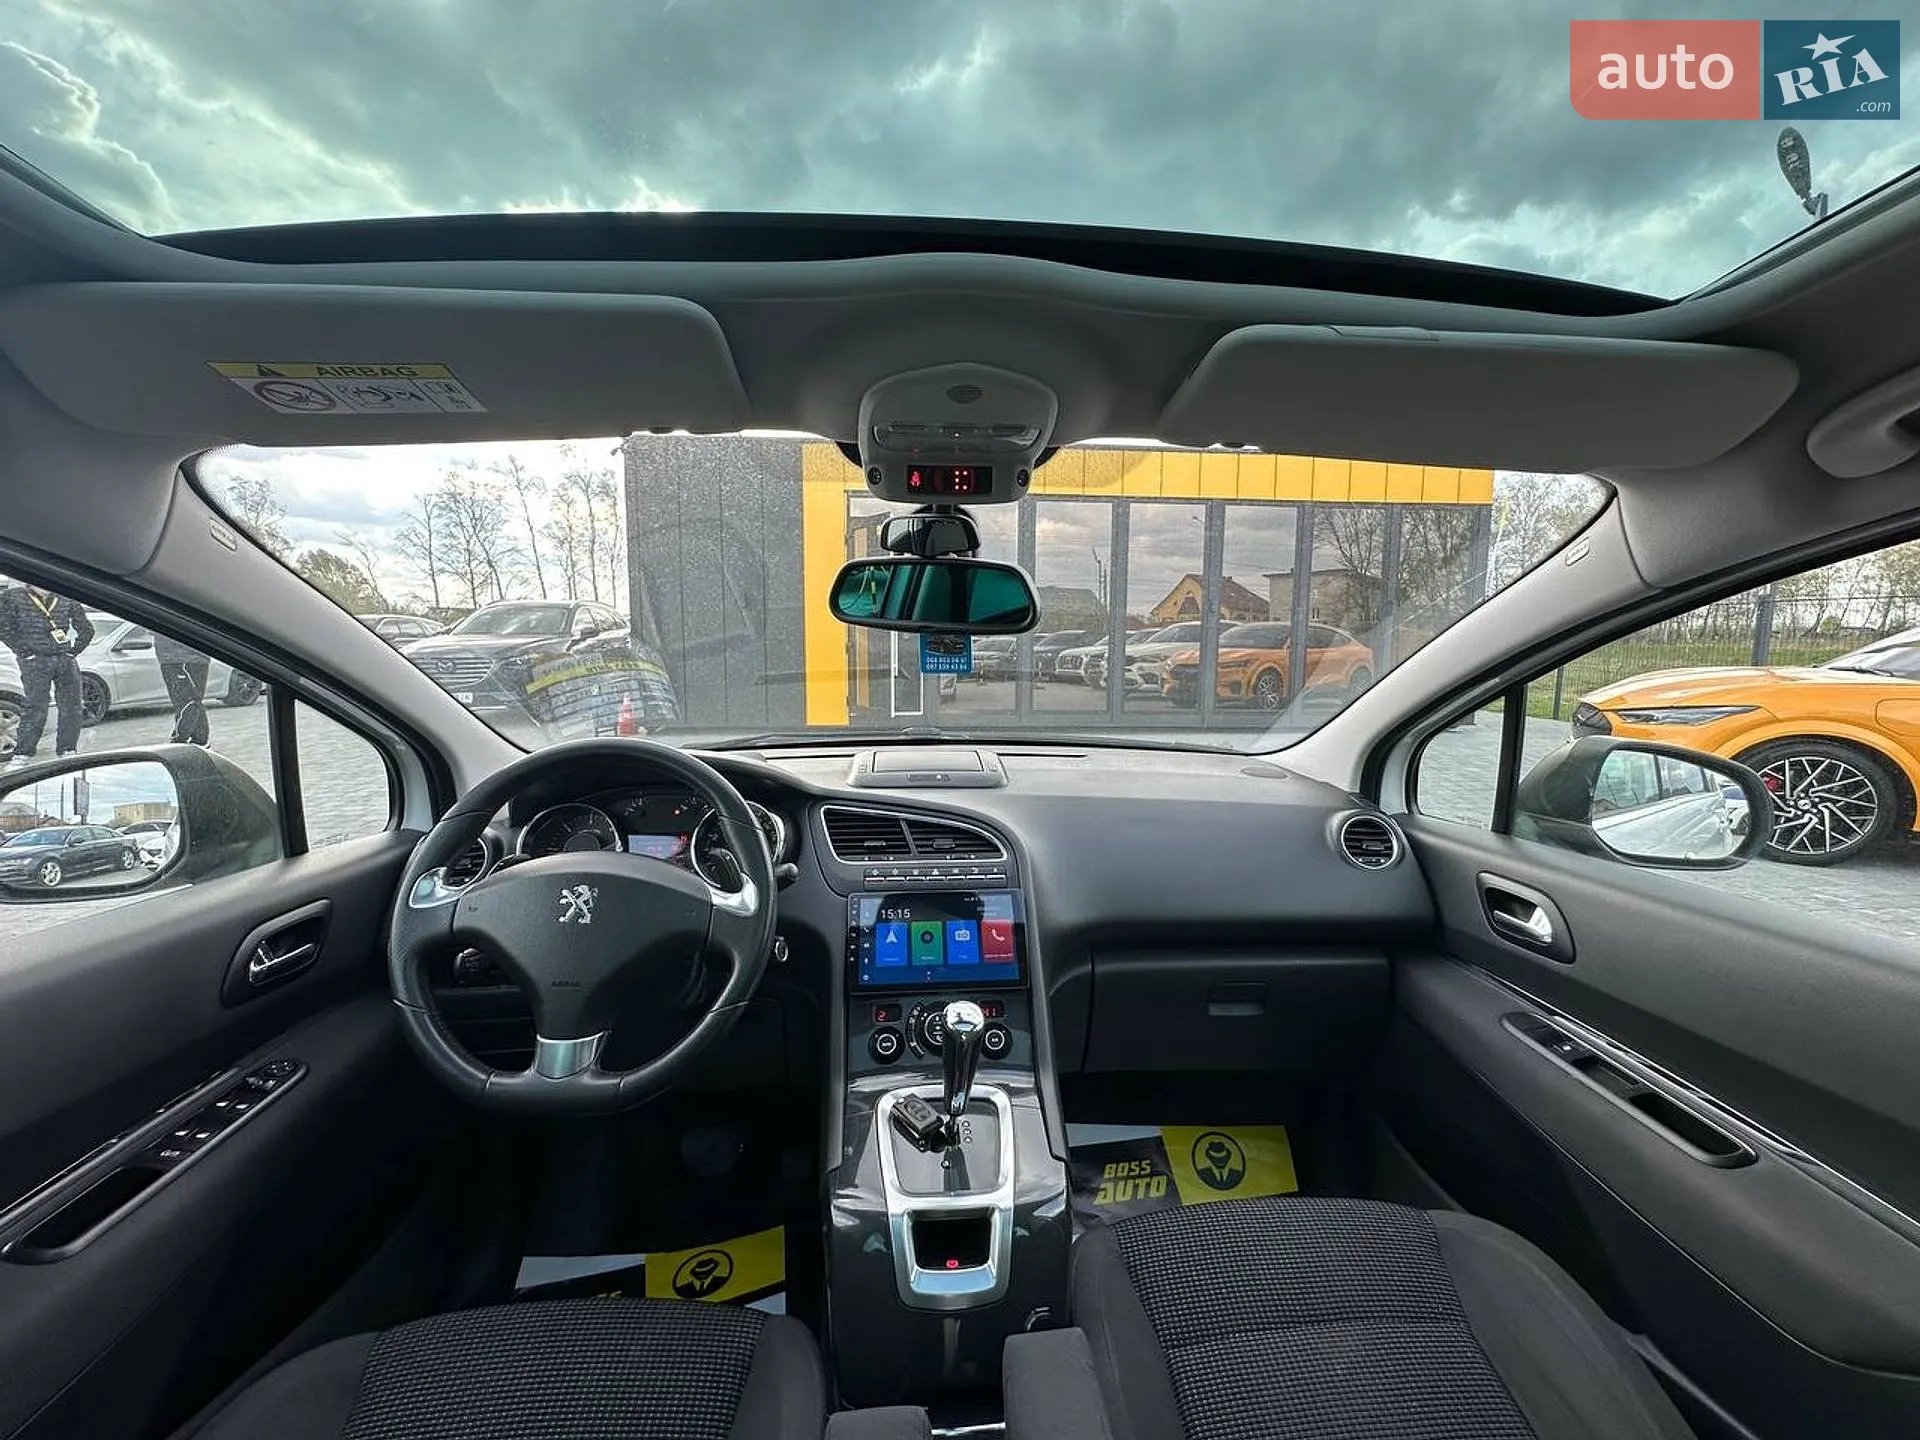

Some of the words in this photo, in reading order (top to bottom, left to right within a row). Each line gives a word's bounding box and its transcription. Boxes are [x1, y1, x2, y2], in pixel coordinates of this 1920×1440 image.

[315, 365, 419, 377] AIRBAG
[881, 908, 911, 919] 15:15
[1104, 1159, 1152, 1179] BOSS
[1093, 1175, 1168, 1205] AUTO
